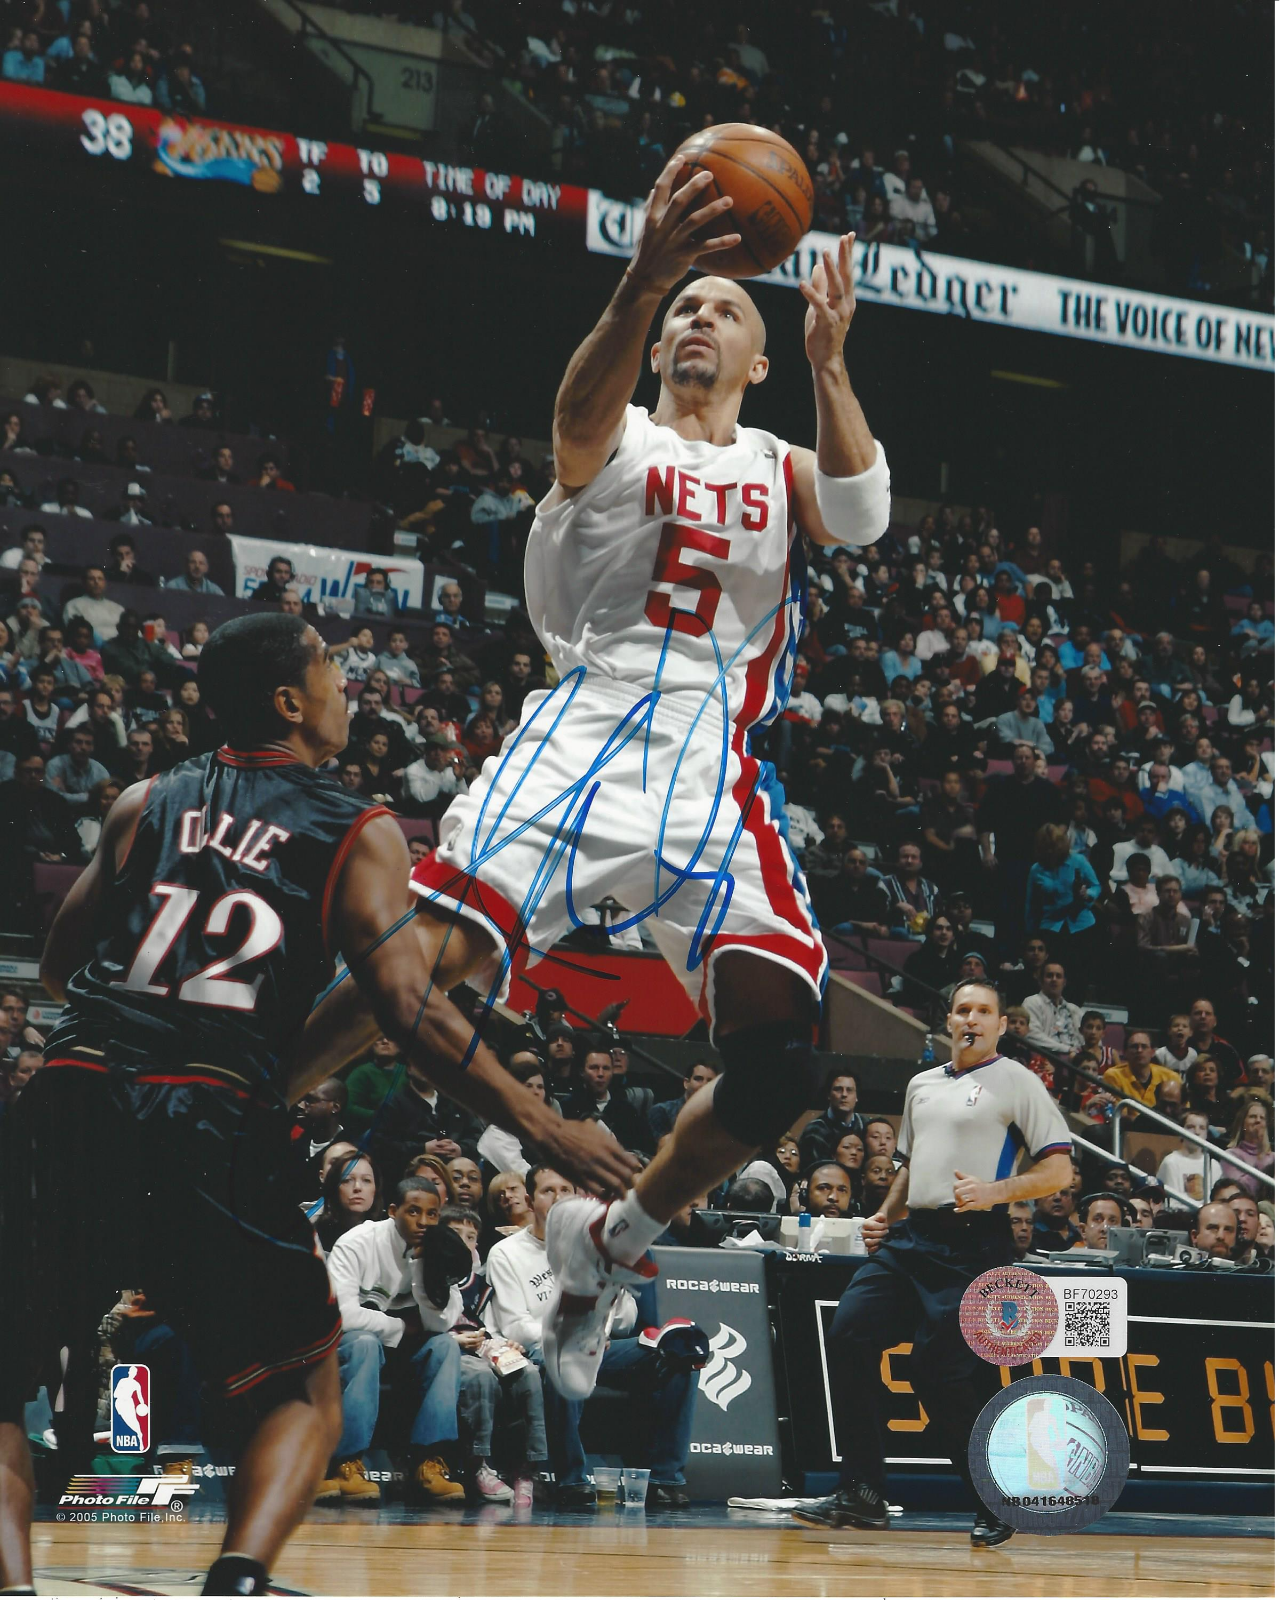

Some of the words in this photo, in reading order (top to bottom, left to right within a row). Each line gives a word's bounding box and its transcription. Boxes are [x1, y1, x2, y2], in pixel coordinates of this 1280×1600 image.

[401, 67, 433, 93] 213
[80, 108, 133, 160] 38
[297, 137, 328, 165] TF
[357, 148, 388, 177] TO
[363, 178, 381, 205] 5
[423, 160, 474, 196] TIME
[484, 172, 511, 200] OF
[522, 179, 561, 210] DAY
[503, 208, 536, 237] PM
[1058, 288, 1107, 333] THE
[1114, 300, 1187, 347] VOICE
[1196, 315, 1227, 354] OF
[645, 465, 769, 533] NETS
[643, 521, 731, 638] 5
[109, 881, 284, 1011] 12
[978, 1276, 1041, 1299] BECKETT
[1063, 1288, 1119, 1300] BF70293
[973, 1330, 1044, 1355] AUTHENTICATED
[1205, 1357, 1275, 1444] 8
